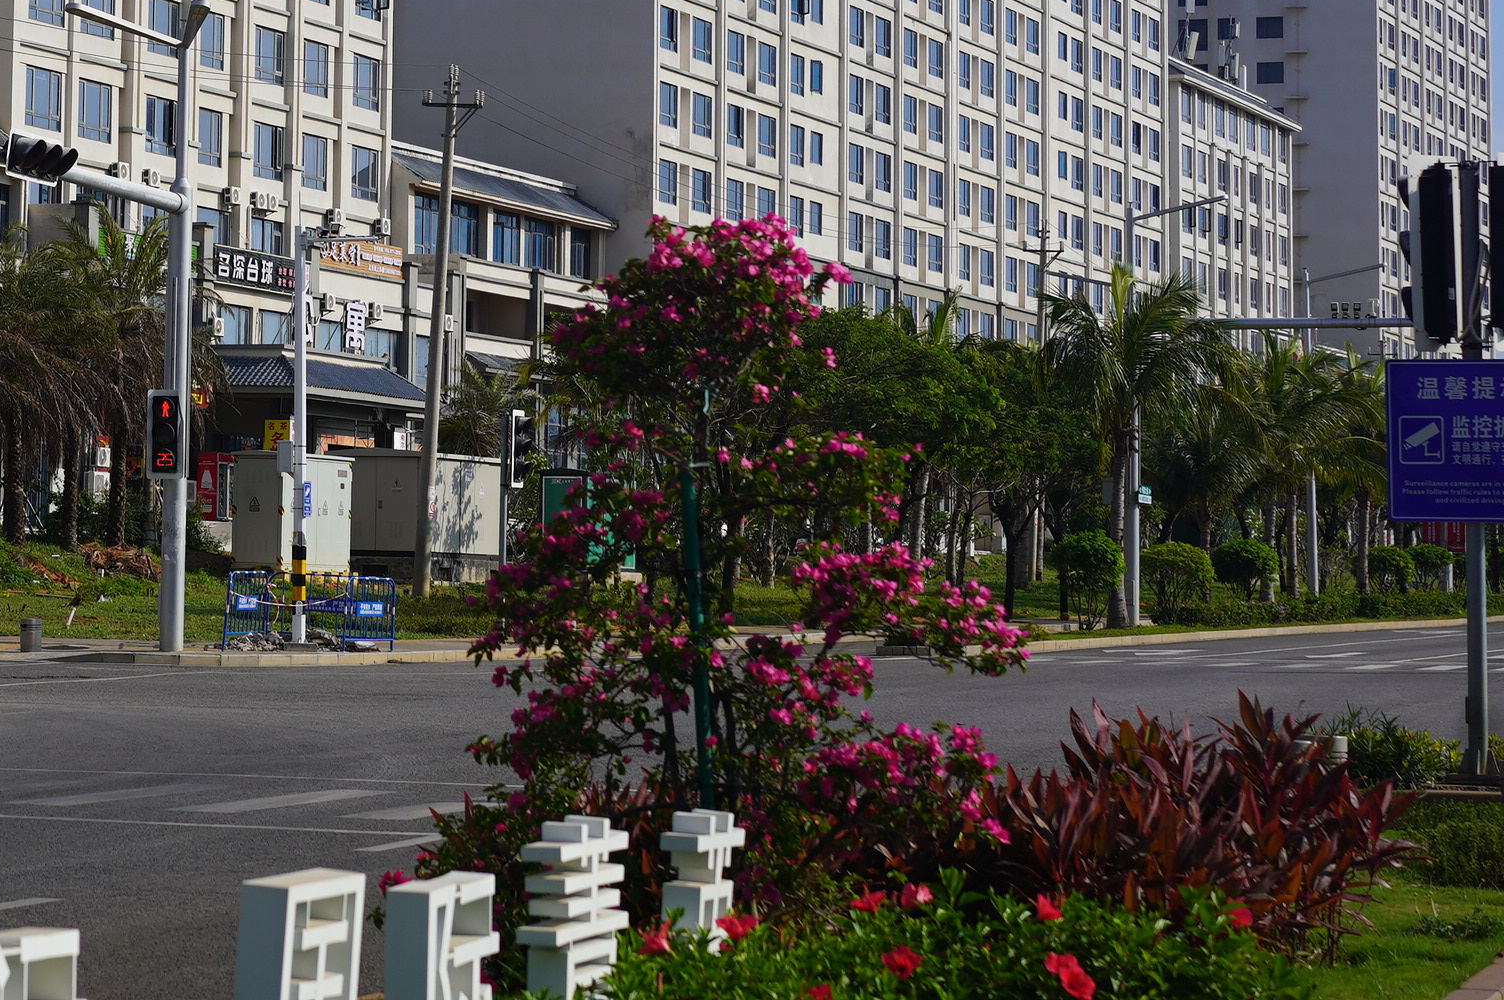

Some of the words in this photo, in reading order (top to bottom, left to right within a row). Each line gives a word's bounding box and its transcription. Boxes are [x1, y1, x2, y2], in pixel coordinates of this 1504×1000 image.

[1417, 375, 1504, 400] 温馨提
[1452, 441, 1504, 453] 请自觉遵守
[157, 453, 174, 467] 25
[1404, 479, 1449, 487] Surveillance
